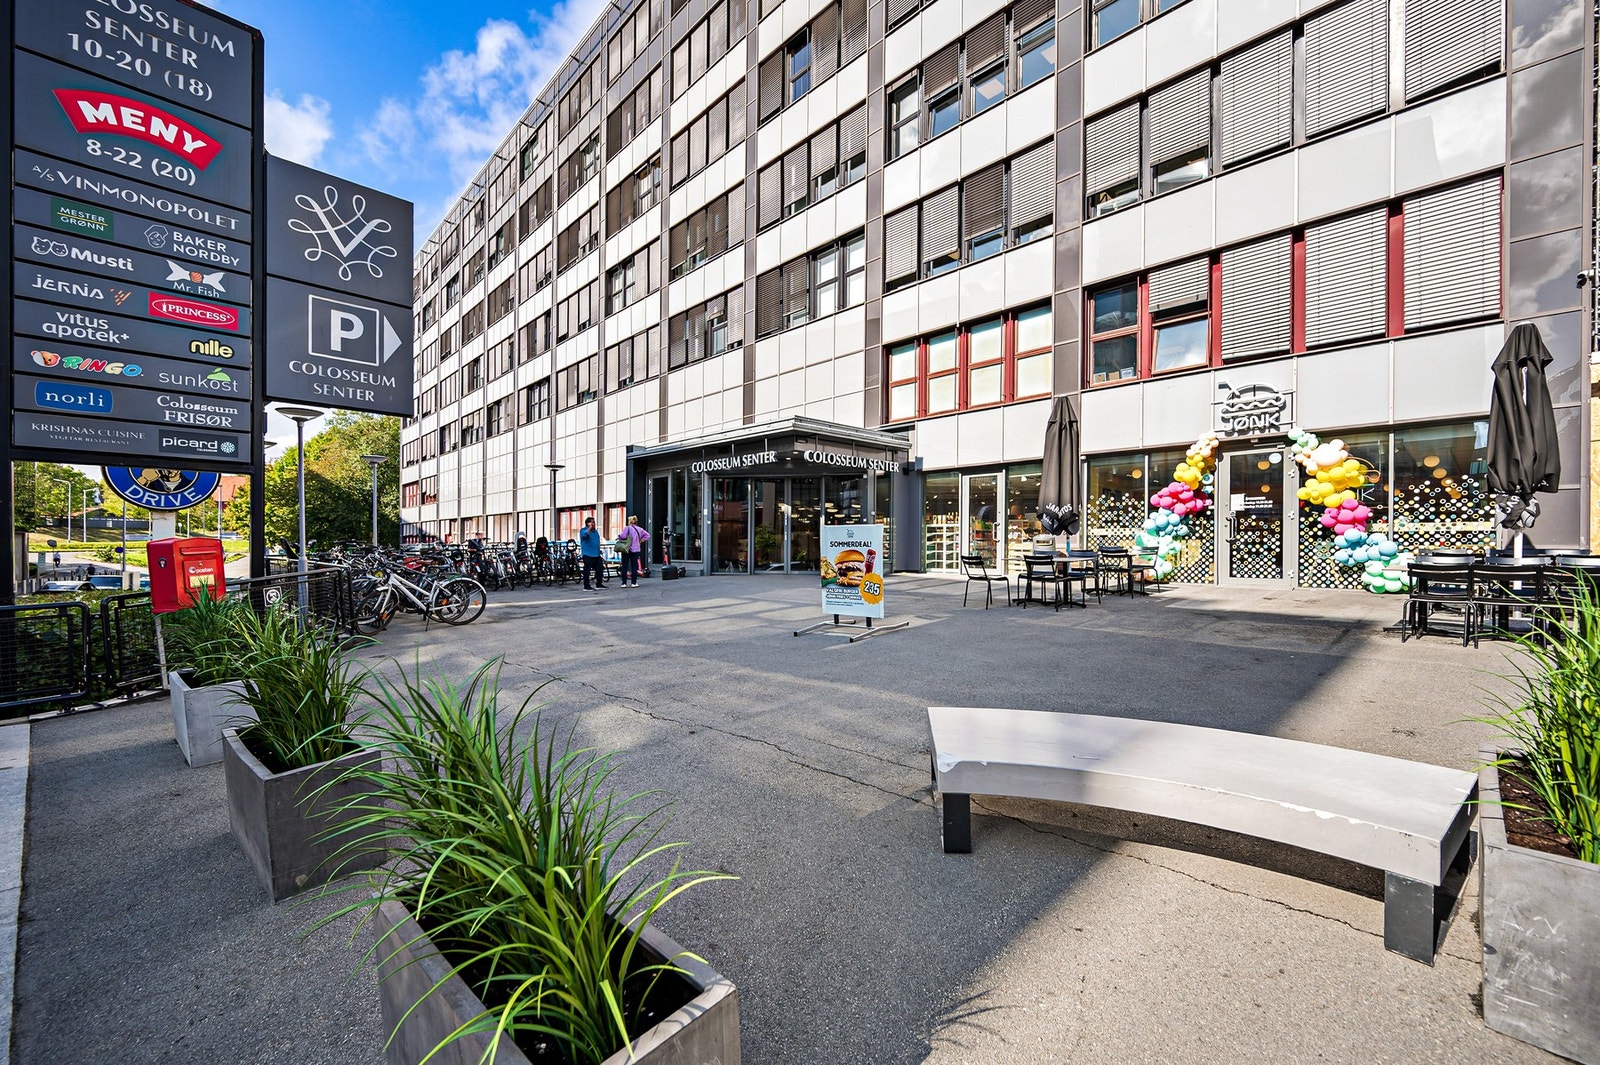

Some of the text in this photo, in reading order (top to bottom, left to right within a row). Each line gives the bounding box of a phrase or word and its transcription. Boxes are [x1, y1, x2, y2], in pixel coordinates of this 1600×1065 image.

[96, 0, 235, 58] OSSEUM
[85, 9, 198, 70] SENTER
[67, 32, 213, 102] 10-20 (18)
[76, 100, 207, 154] MENY
[86, 139, 197, 187] 8-22 (20)
[32, 165, 239, 231] A/S VINMONOPOLET
[60, 206, 106, 223] MESTER
[60, 216, 105, 232] GRØNN
[173, 231, 227, 252] BAKER
[70, 247, 134, 271] Musti
[173, 244, 240, 266] NORDBY
[172, 281, 220, 298] Mr. Fish
[56, 311, 109, 330] vitus
[330, 309, 364, 352] P
[190, 340, 233, 358] nille
[159, 372, 239, 393] sunkost
[288, 360, 396, 388] COLOSSEUM
[45, 389, 105, 407] norli
[313, 382, 375, 402] SENTER
[157, 395, 239, 415] Colosseum
[164, 410, 233, 428] FRISØR
[1224, 412, 1280, 432] JØNK
[31, 422, 146, 440] KRISHNAS CUISINE
[162, 436, 218, 449] picard
[691, 451, 776, 473] COLOSSEUM SENTER
[805, 450, 900, 473] COLOSSEUM SENTER
[124, 484, 202, 507] DRIVE
[829, 540, 872, 548] SOMMERDEAL!
[196, 566, 214, 574] posten
[864, 581, 881, 596] 235
